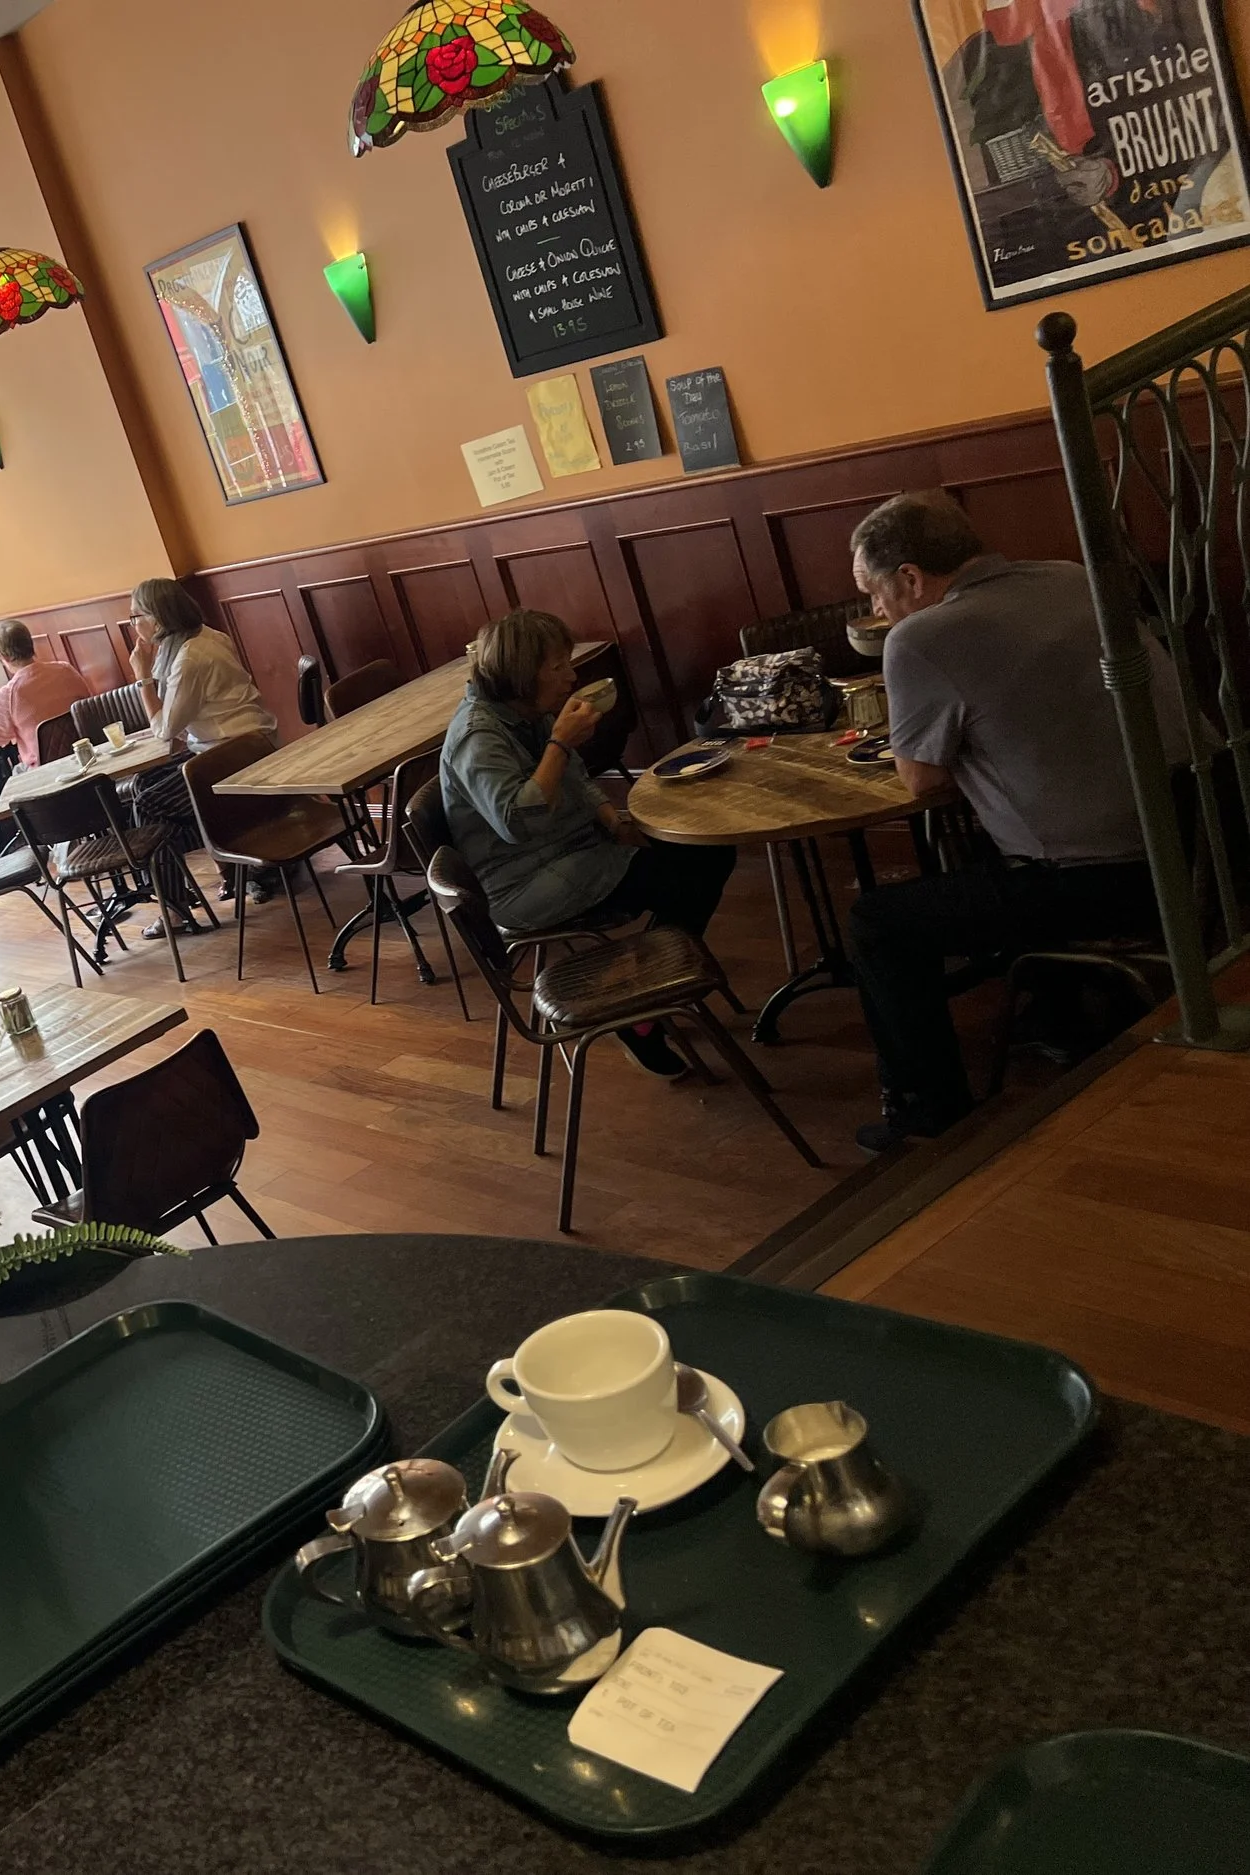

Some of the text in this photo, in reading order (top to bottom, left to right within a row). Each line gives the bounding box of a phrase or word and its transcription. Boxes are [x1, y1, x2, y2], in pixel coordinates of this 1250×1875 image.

[1087, 43, 1210, 108] aristide
[1108, 86, 1218, 178] BRUANT
[534, 190, 548, 205] OR
[1130, 173, 1196, 205] dans
[547, 249, 579, 268] ONION
[1066, 227, 1134, 260] son
